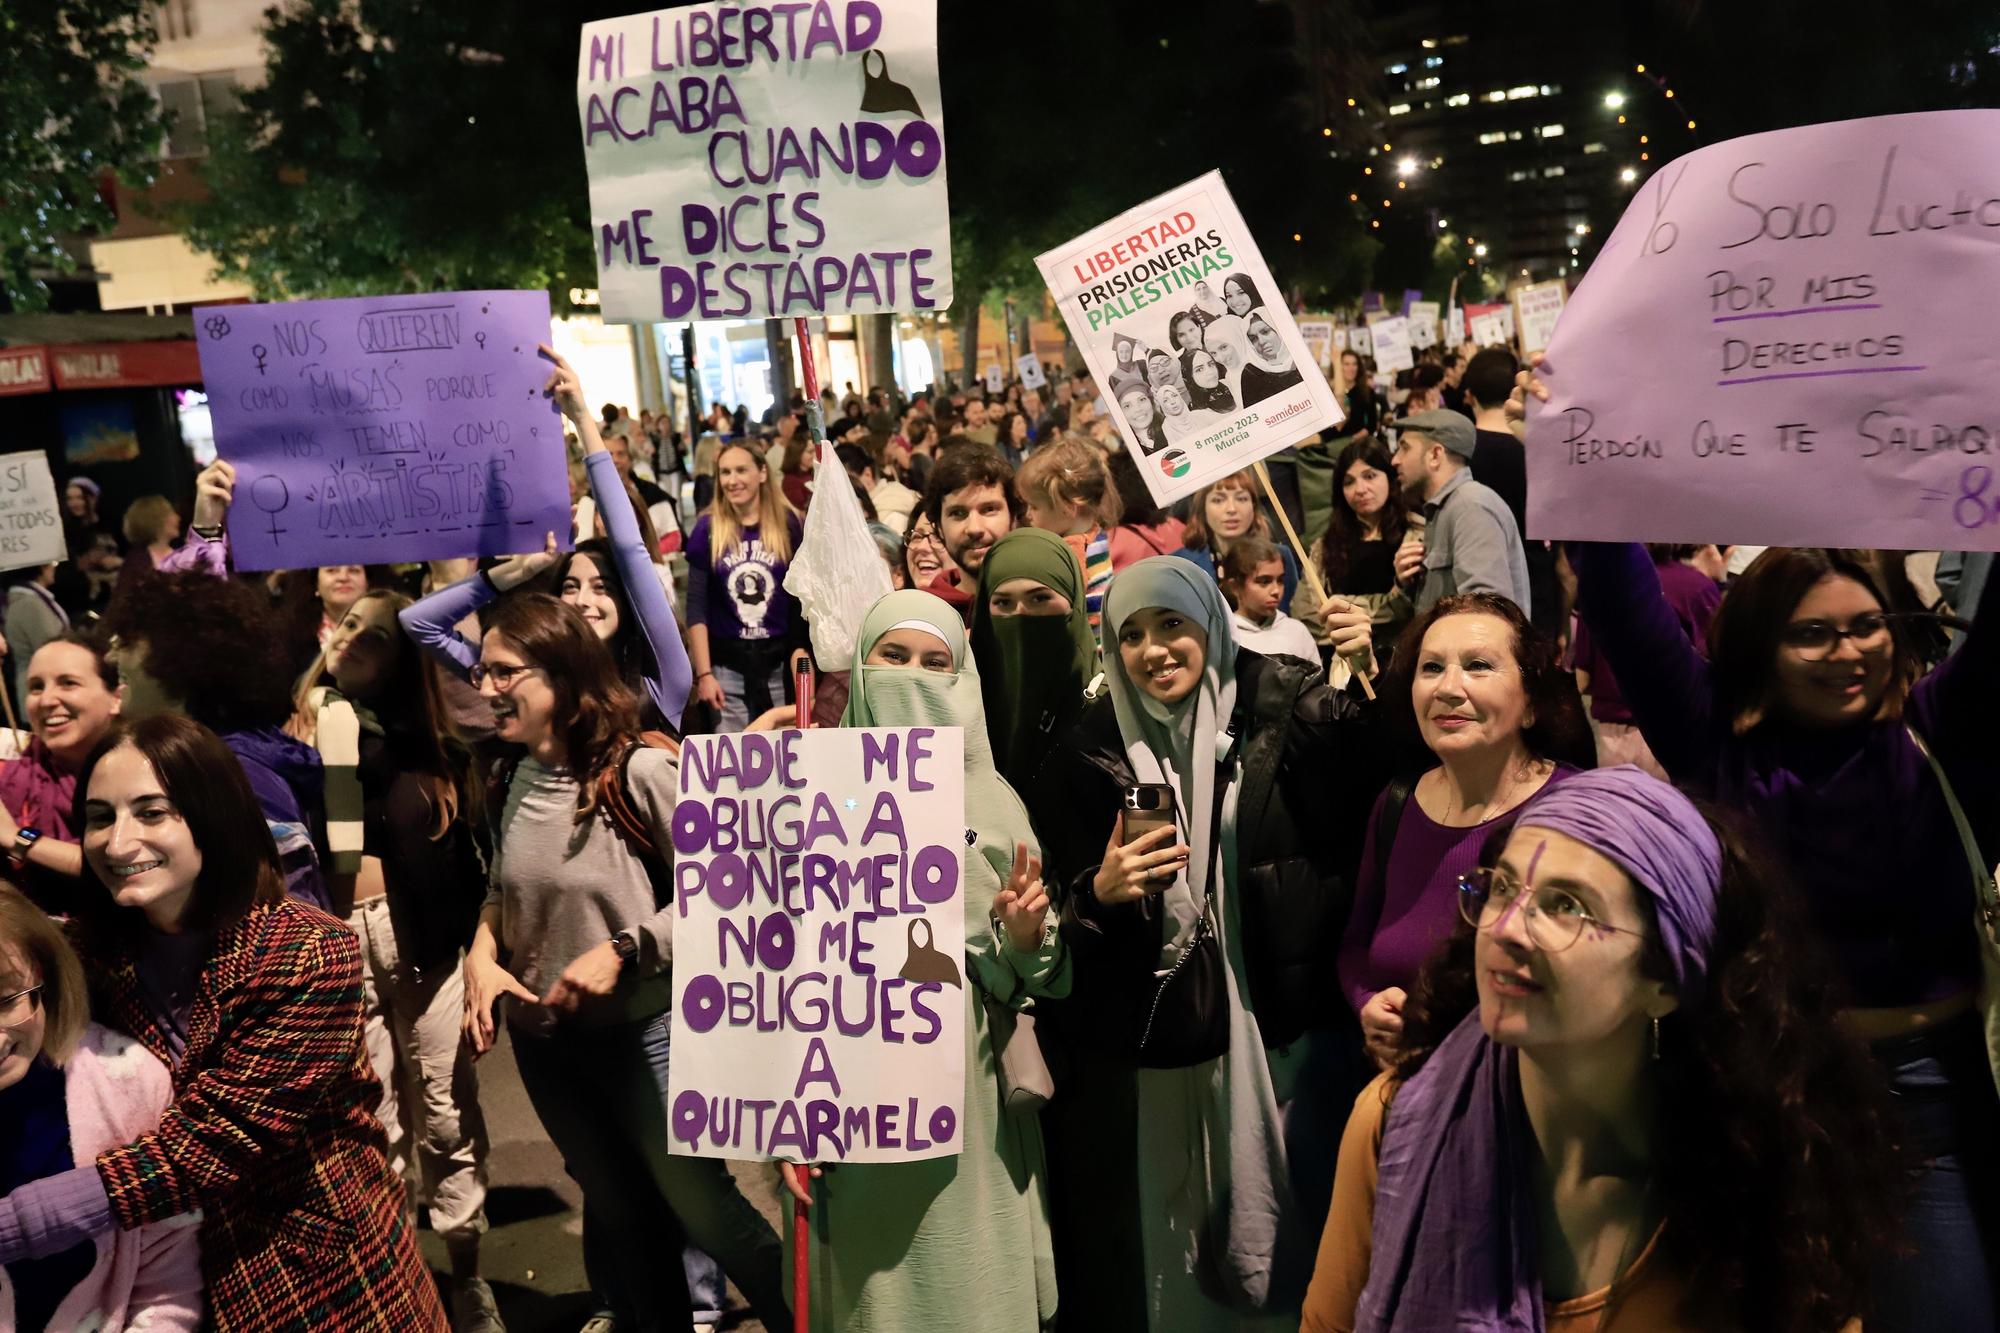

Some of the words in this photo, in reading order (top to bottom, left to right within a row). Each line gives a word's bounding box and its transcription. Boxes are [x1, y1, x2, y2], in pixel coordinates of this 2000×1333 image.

[589, 32, 624, 81] MI
[651, 0, 882, 71] LIBERTAD
[586, 75, 748, 146] ACABA
[708, 120, 942, 188] CUANDO
[602, 210, 660, 267] ME
[681, 192, 826, 256] DICES
[1073, 211, 1196, 285] LIBERTAD
[660, 248, 935, 319] DESTÁPATE
[1077, 229, 1222, 311] PRISIONERAS
[1086, 246, 1234, 332] PALESTINAS
[1803, 274, 1877, 303] MIS
[273, 320, 327, 356] NOS
[357, 313, 460, 350] QUIEREN
[240, 385, 288, 411] COMO
[310, 365, 403, 408] MUSAS
[426, 373, 497, 401] PORQUE
[281, 431, 323, 458] NOS
[347, 421, 428, 453] TEMEN
[453, 420, 511, 447] COMO
[1195, 440, 1203, 450] 8
[1204, 427, 1235, 446] marzo
[1234, 413, 1260, 430] 2023
[1215, 431, 1250, 452] Murcia
[1775, 423, 1819, 454] TE
[1857, 410, 2000, 458] SALPQ
[5, 509, 55, 529] TODAS
[318, 457, 513, 530] ARTISTAS
[681, 729, 808, 794] NADIE
[863, 728, 935, 791] ME
[672, 791, 848, 854] OBLIGA
[861, 791, 907, 851] A
[675, 845, 959, 918] PONERMELO
[718, 911, 795, 970] NO
[819, 912, 877, 975] ME
[681, 972, 942, 1045] OBLIGUES
[794, 1038, 841, 1098] A
[672, 1090, 956, 1160] QUITARMELO
